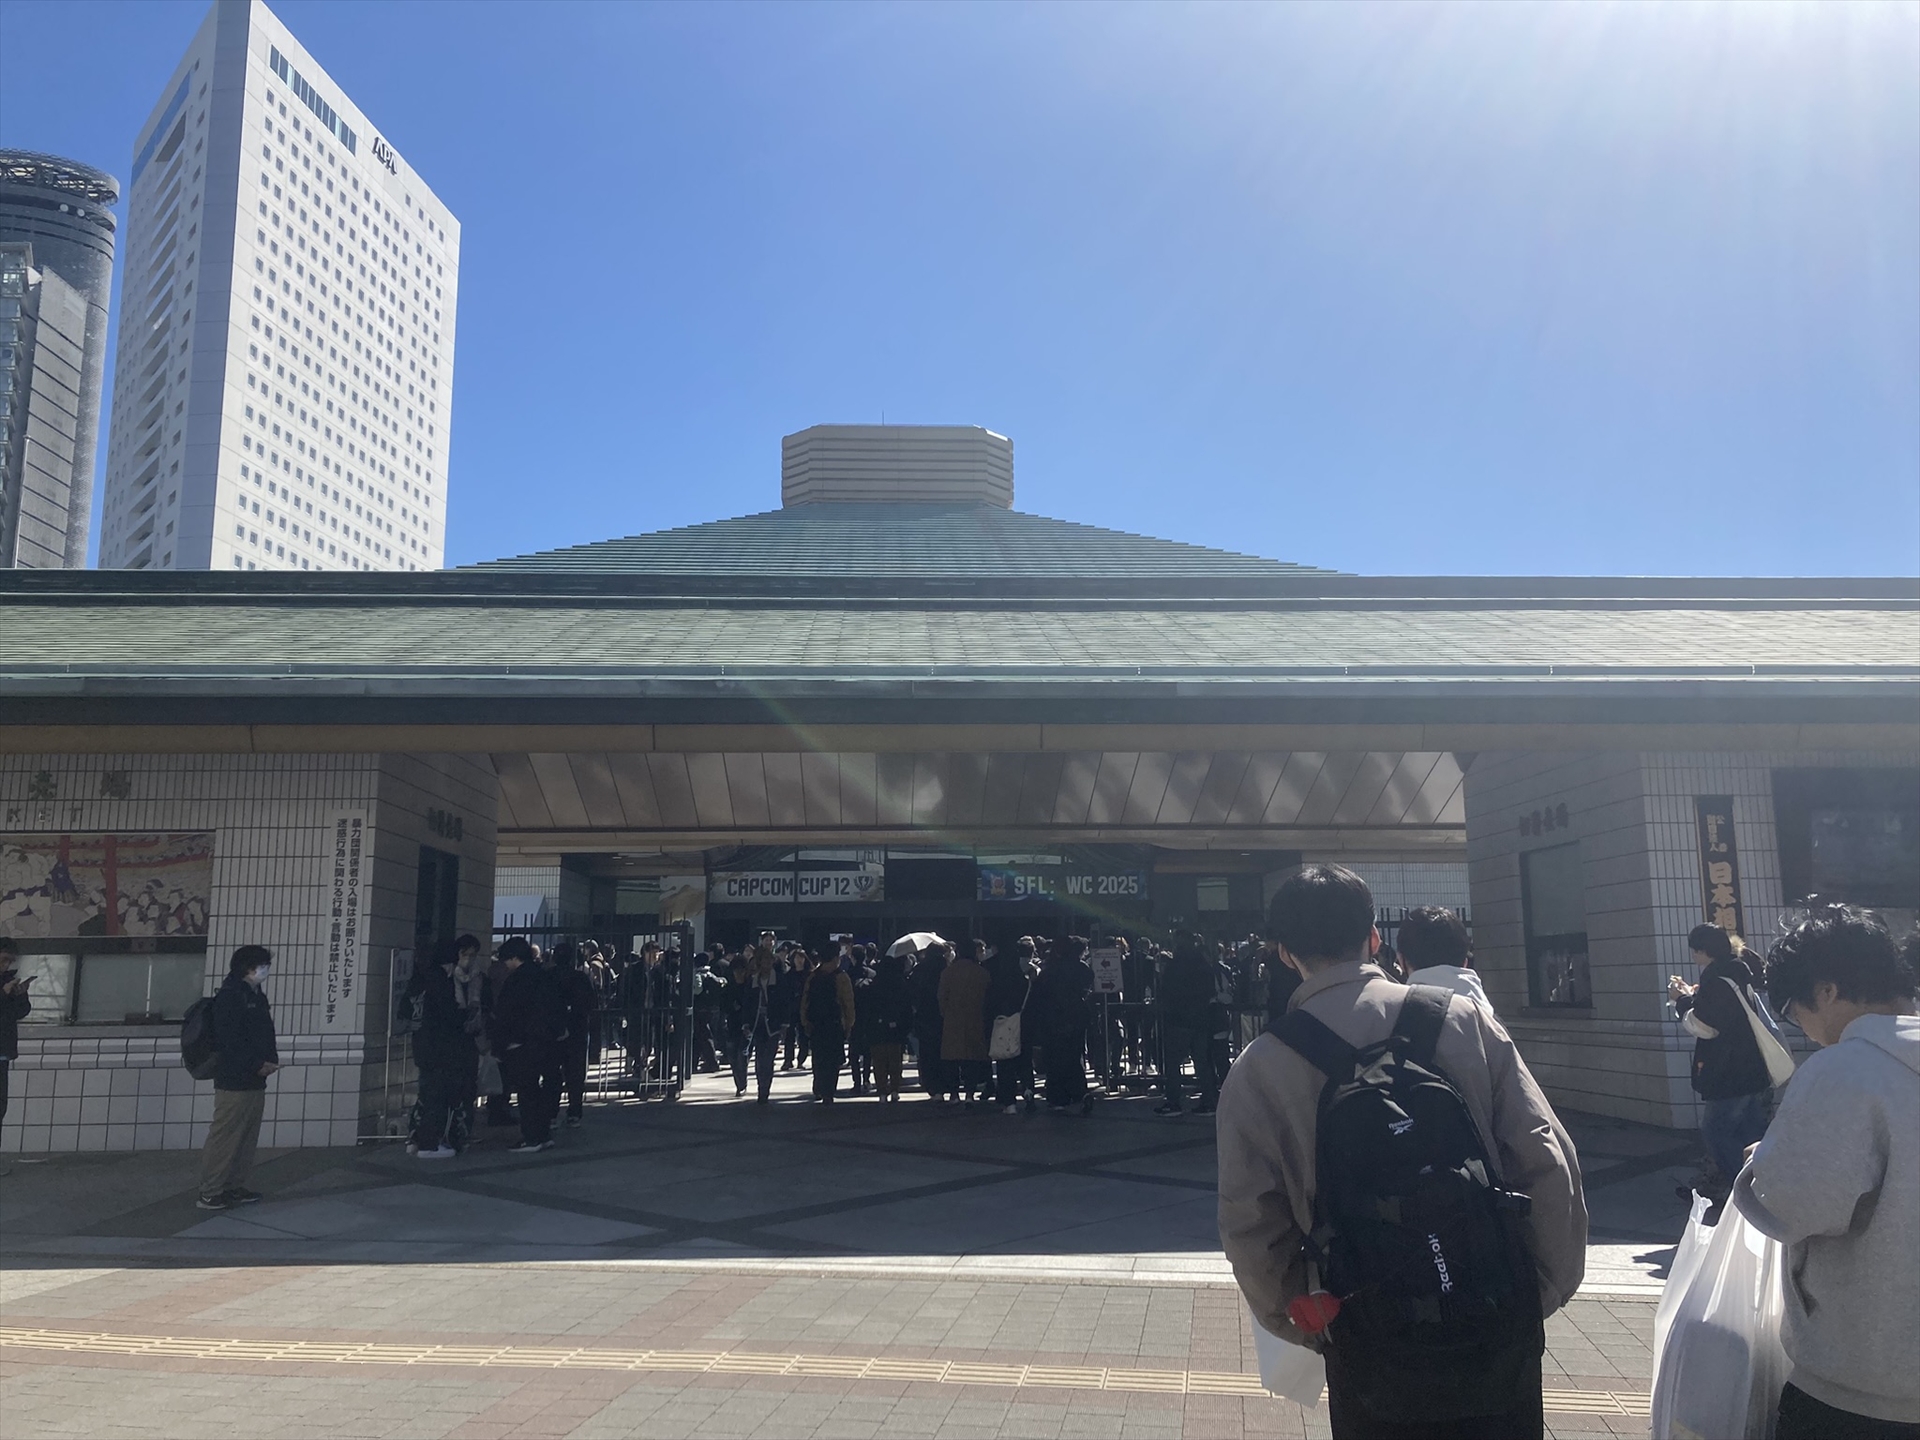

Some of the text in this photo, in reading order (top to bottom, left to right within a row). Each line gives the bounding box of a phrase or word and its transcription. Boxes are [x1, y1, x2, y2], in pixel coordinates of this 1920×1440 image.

[371, 136, 397, 175] APA
[727, 877, 850, 896] CAPCOM CUP 12
[1014, 876, 1139, 895] SFL: WC 2025
[1708, 861, 1737, 938] 日本相
[325, 818, 348, 1024] 迷惑行為に関わる行動・言動は禁止いたします
[340, 818, 362, 998] 暴力団関係者の入場はお断りいたします
[1388, 1118, 1414, 1130] Reebok
